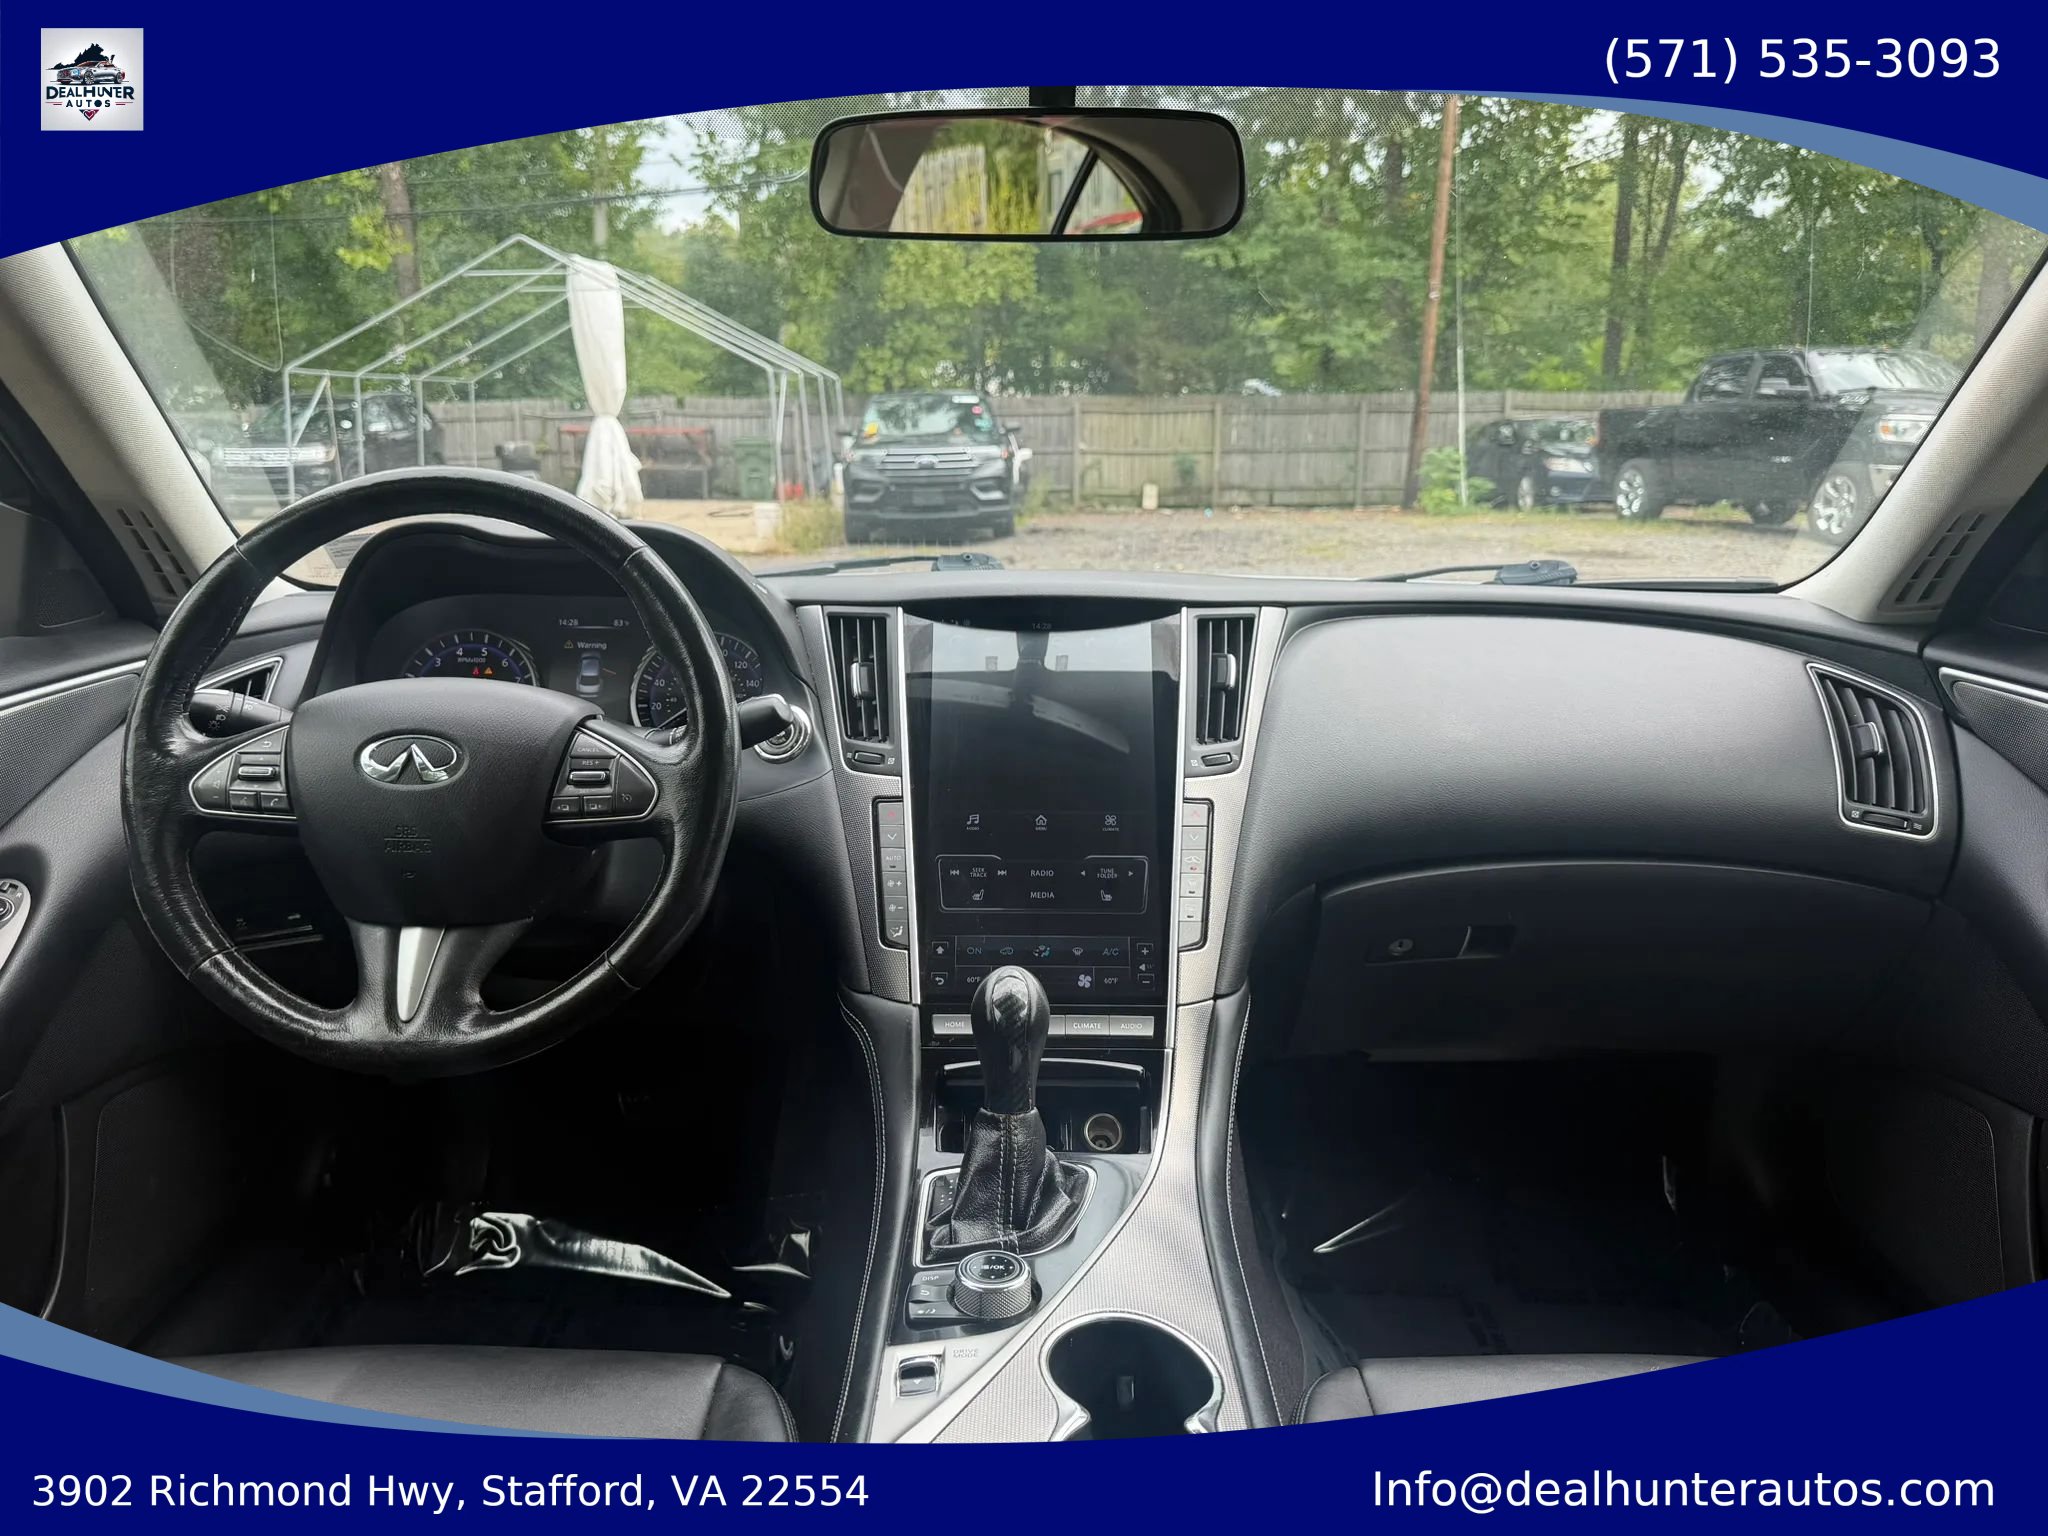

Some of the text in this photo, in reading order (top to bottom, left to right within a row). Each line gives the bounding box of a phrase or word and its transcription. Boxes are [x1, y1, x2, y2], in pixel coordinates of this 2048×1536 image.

[577, 641, 608, 651] Warning
[456, 647, 463, 656] 4
[481, 647, 488, 657] 5
[434, 657, 441, 667] 3
[501, 658, 509, 668] 6
[734, 660, 748, 669] 120
[653, 678, 665, 688] 40
[746, 679, 760, 689] 140
[651, 702, 662, 711] 20
[1030, 869, 1055, 877] RADIO
[1030, 891, 1055, 899] MEDIA
[966, 946, 982, 955] ON
[1102, 946, 1119, 956] A/C
[1073, 1022, 1101, 1030] CLIMATE
